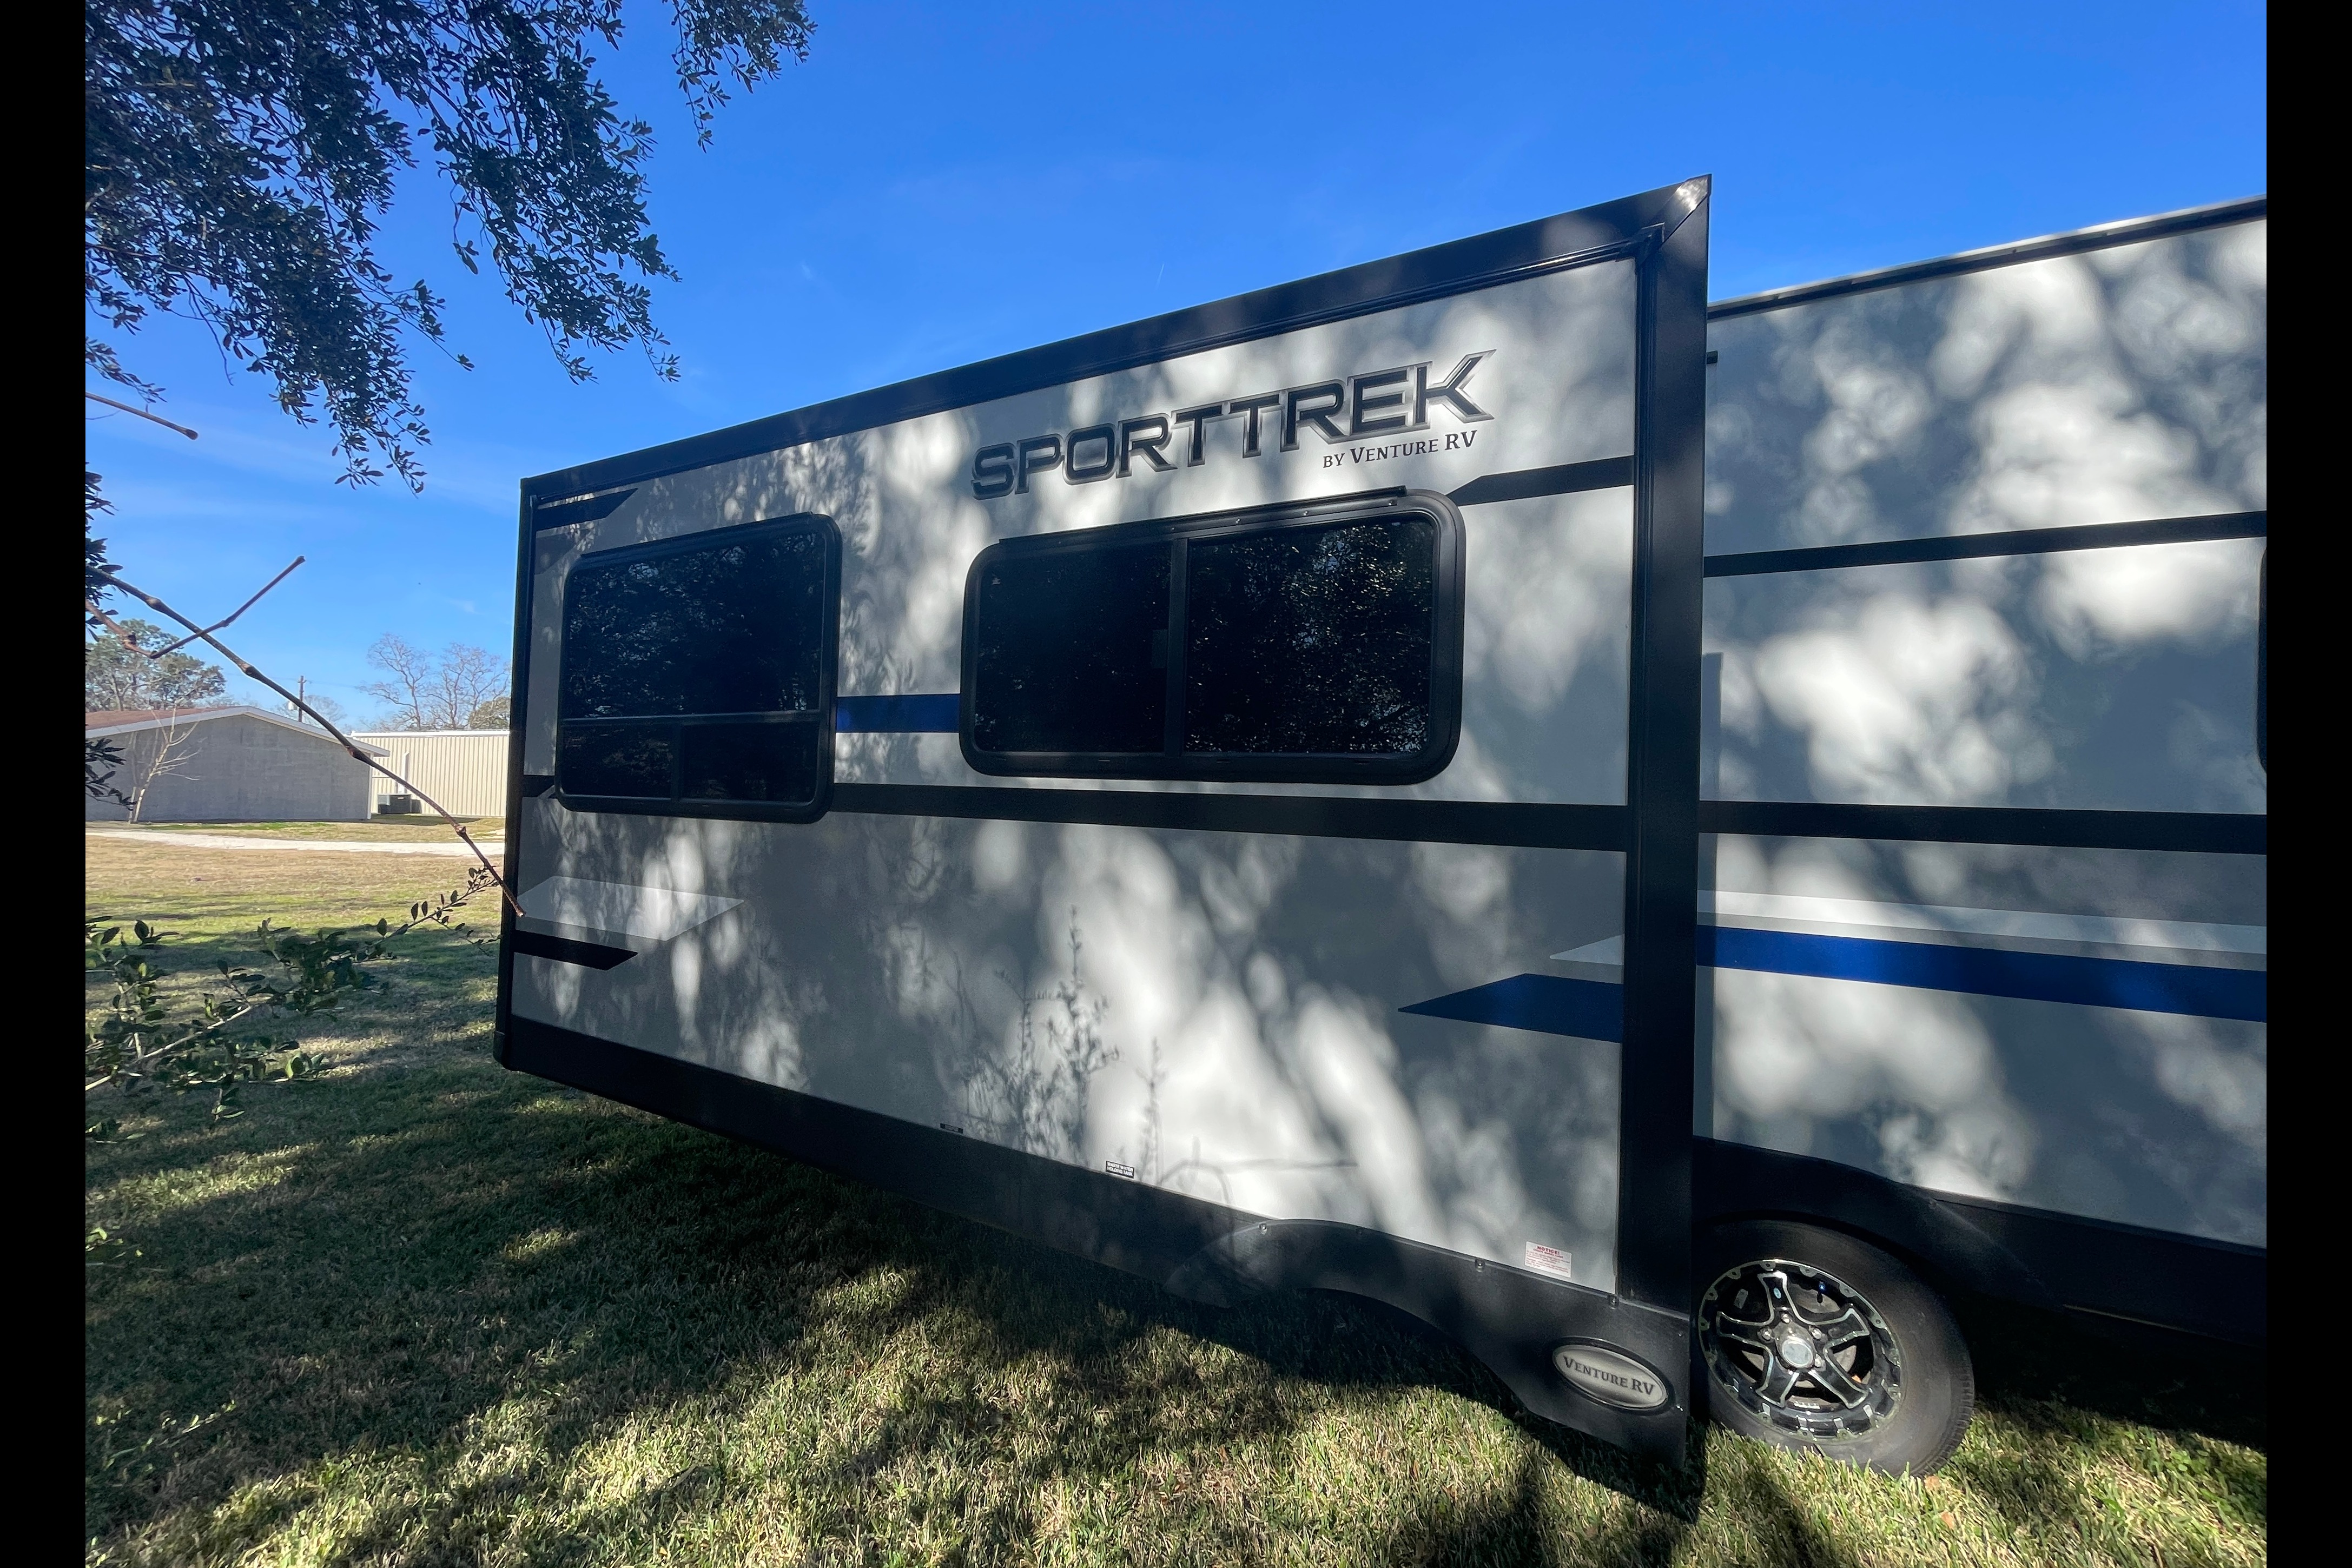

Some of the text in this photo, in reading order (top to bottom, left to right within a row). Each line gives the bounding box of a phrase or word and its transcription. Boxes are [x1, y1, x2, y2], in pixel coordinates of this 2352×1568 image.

[972, 349, 1497, 500] SPORTTREK
[1323, 429, 1477, 468] BY VENTURE RV
[1537, 1246, 1560, 1255] NOTICE!
[1563, 1355, 1655, 1395] VENTURE RV
